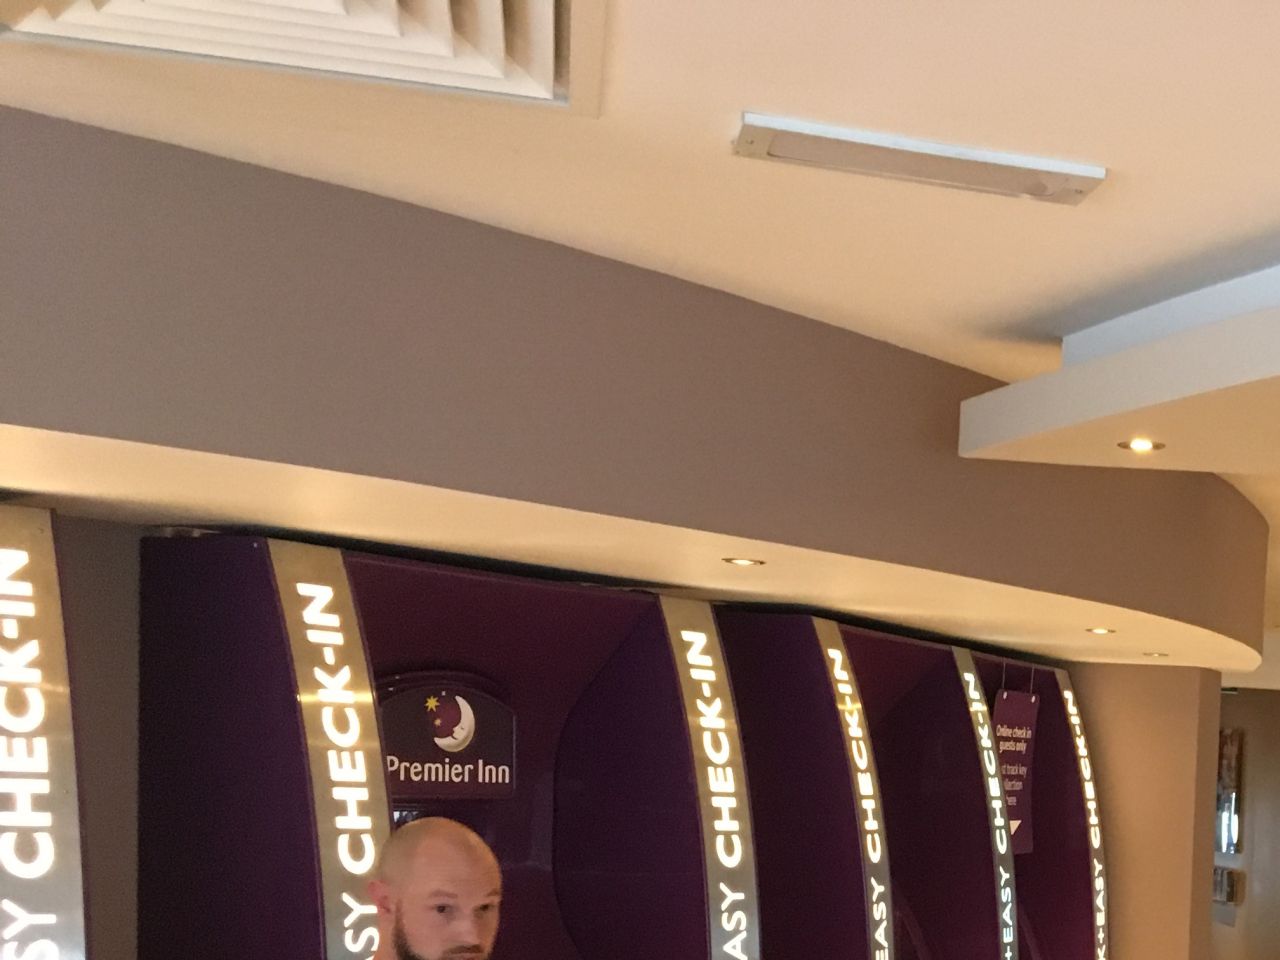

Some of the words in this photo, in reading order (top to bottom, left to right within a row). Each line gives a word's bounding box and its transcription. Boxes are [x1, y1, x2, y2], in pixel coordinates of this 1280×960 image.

[0, 548, 55, 879] CHECK-IN
[297, 582, 376, 875] CHECK-IN
[386, 755, 473, 783] Premier
[478, 759, 510, 783] Inn
[681, 630, 743, 868] CHECK-IN
[828, 648, 882, 864] CHECK-IN
[964, 672, 1008, 855] CHECK-IN
[1063, 690, 1101, 849] CHECK-IN
